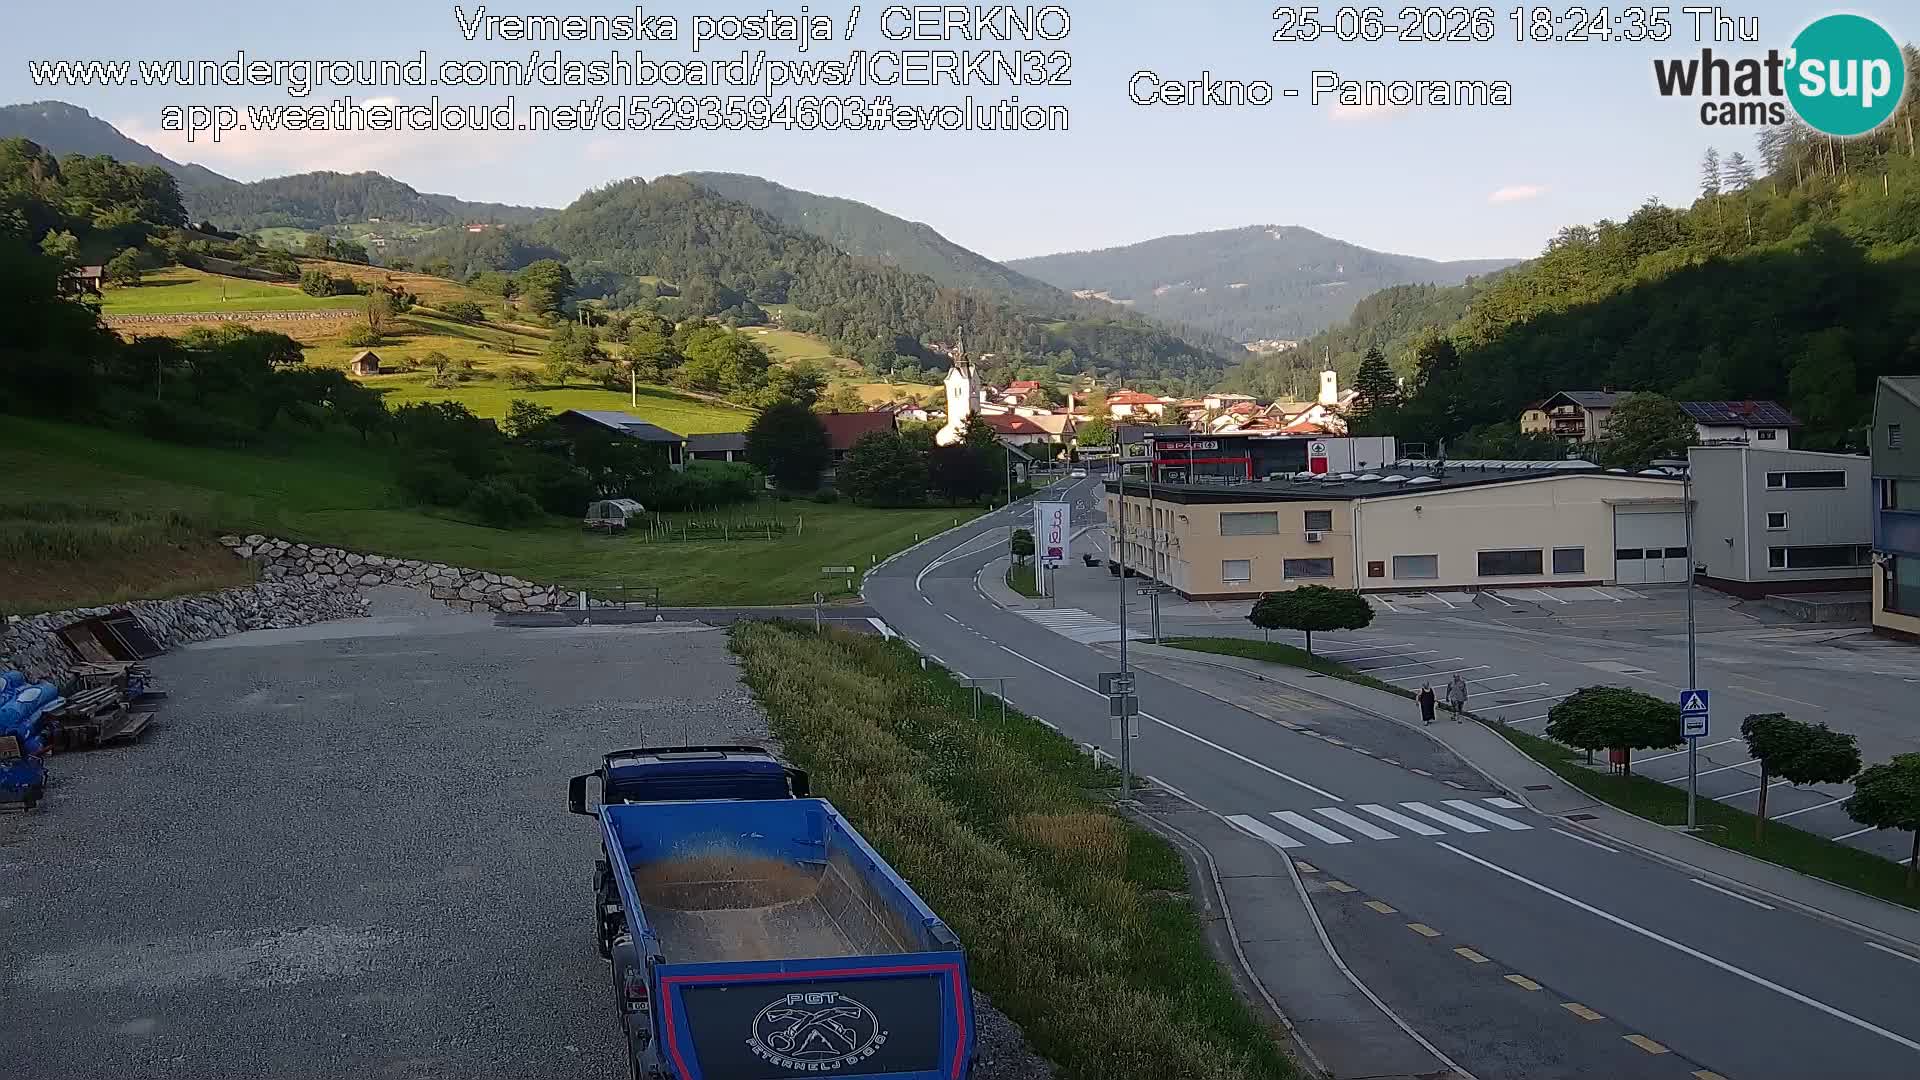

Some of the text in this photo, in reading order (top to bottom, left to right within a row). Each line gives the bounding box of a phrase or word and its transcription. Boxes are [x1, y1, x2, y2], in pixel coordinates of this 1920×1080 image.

[1166, 441, 1203, 450] SPAR
[786, 991, 840, 1006] PGT
[745, 1037, 841, 1071] PETERNELJ
